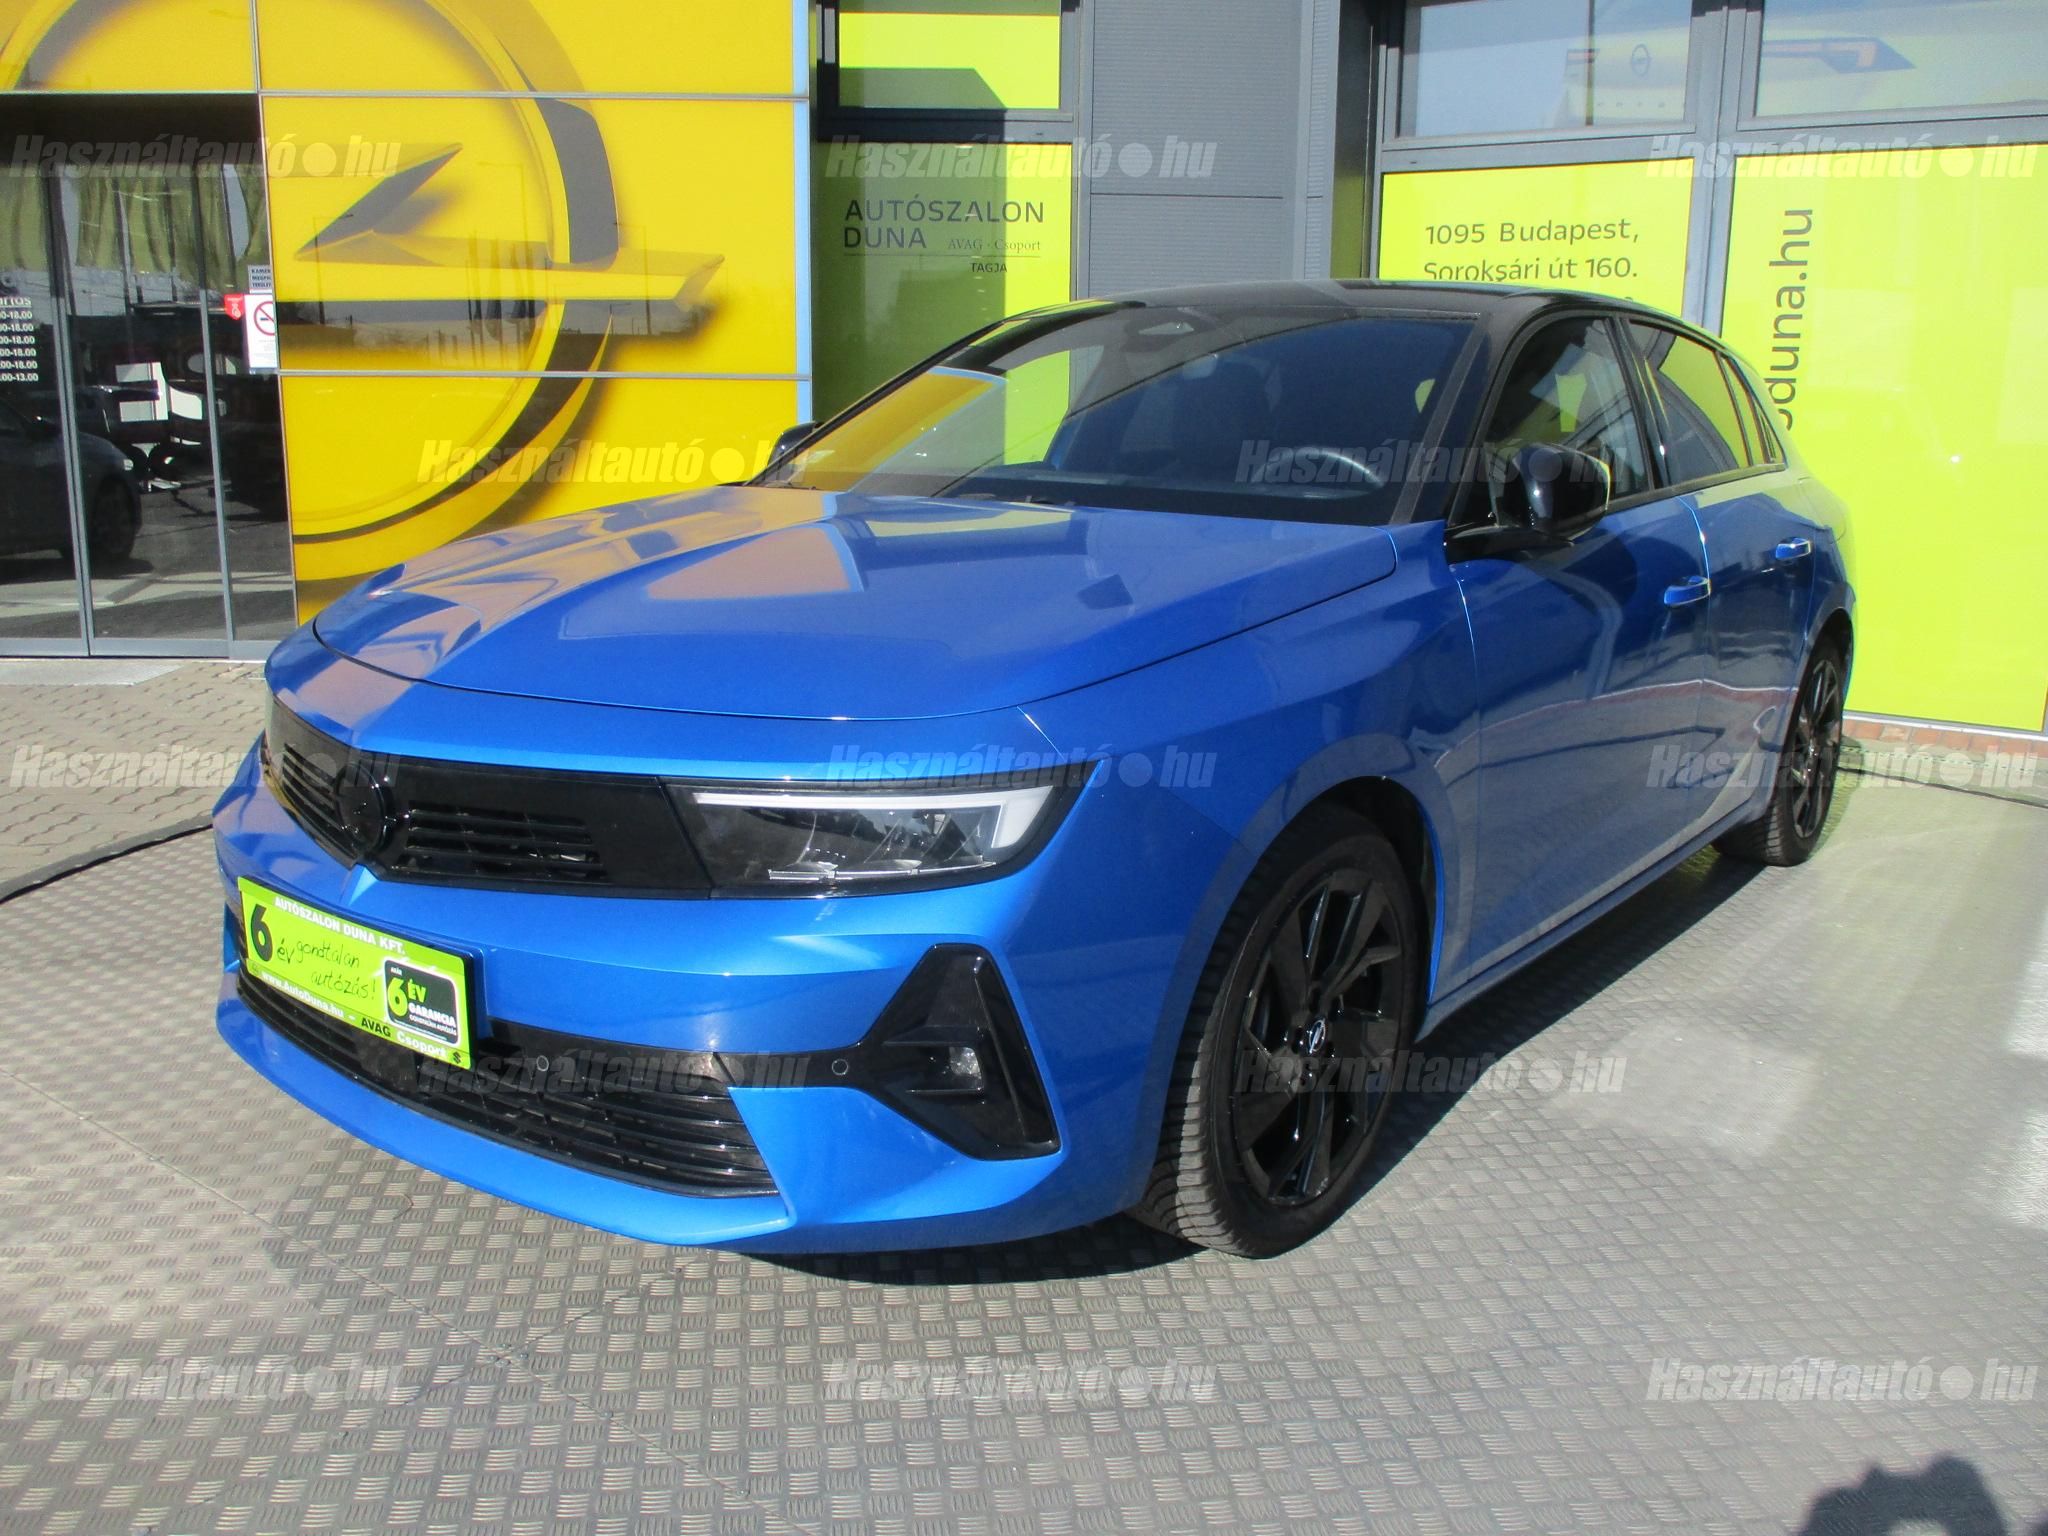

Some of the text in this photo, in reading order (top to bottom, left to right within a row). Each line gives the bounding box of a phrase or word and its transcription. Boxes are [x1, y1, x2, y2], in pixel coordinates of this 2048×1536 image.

[845, 193, 1044, 223] AUTÓSZALON
[844, 227, 1041, 254] DUNA AVAG Csoport
[1425, 219, 1639, 245] 1095 Budapest,
[971, 262, 1008, 273] TAGJA
[1424, 257, 1638, 282] Soroksári út 160.
[250, 903, 360, 967] 6 év gondtalan
[274, 896, 406, 955] AUTÓSZALON DUNA KFT.
[387, 976, 427, 1017] 6 ÉV
[361, 1017, 391, 1037] AVAG
[396, 1030, 448, 1057] Csoport
